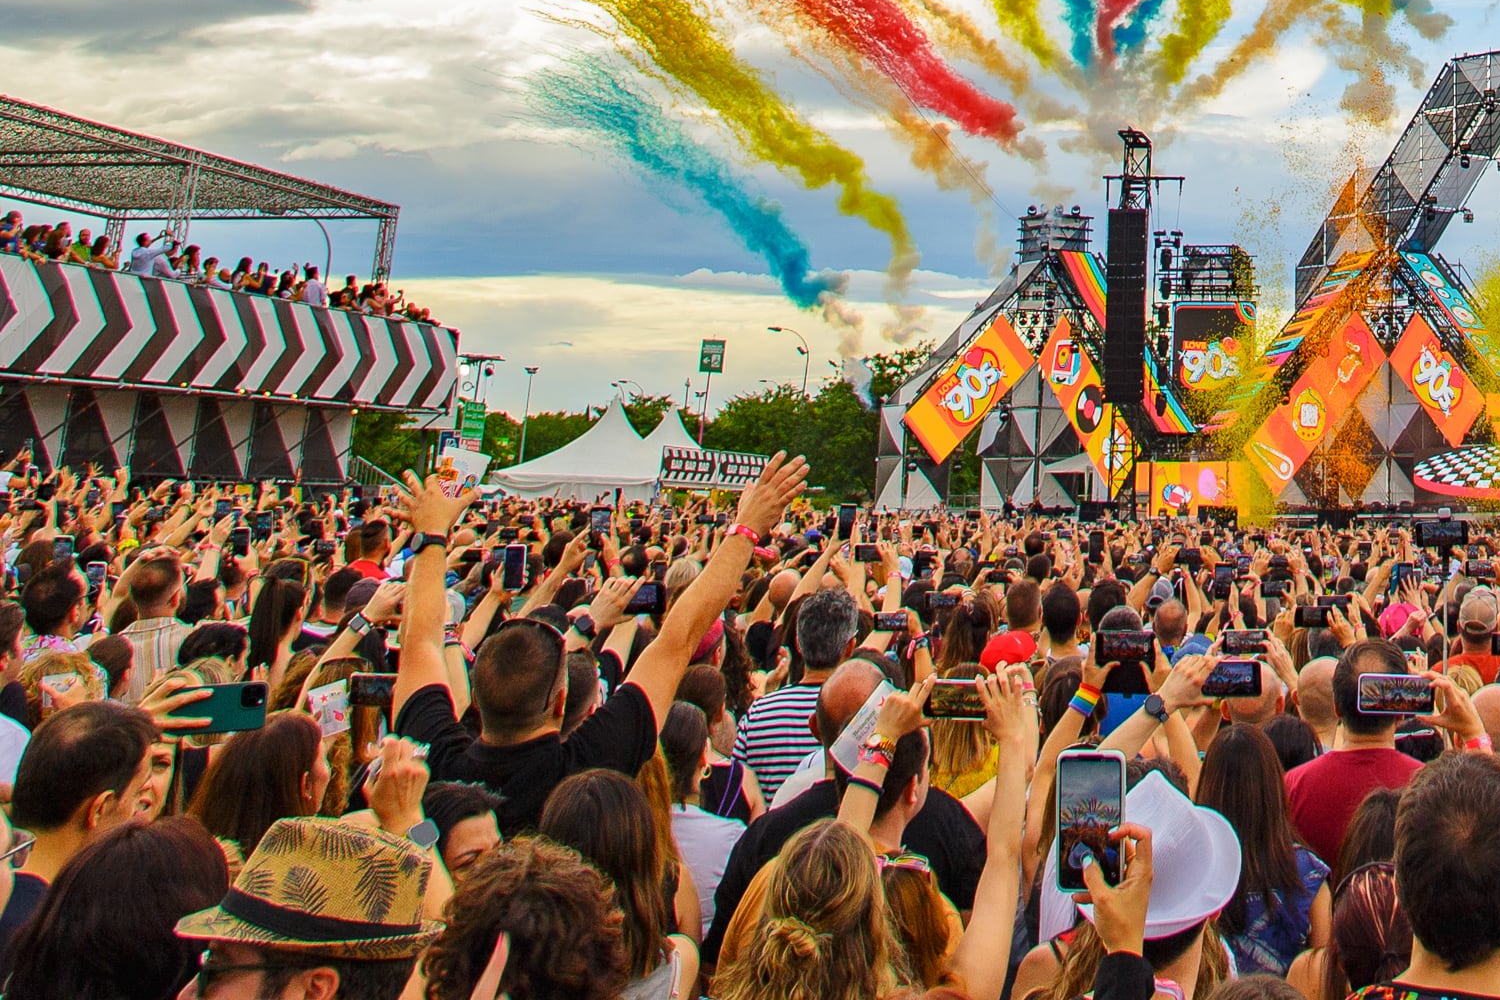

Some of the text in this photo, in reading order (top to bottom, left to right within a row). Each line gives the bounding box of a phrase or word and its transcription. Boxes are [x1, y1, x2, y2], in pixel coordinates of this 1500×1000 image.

[1183, 349, 1241, 383] 90s
[1184, 341, 1207, 350] LOVE
[945, 360, 1000, 421] 90s
[1415, 350, 1455, 412] 90s
